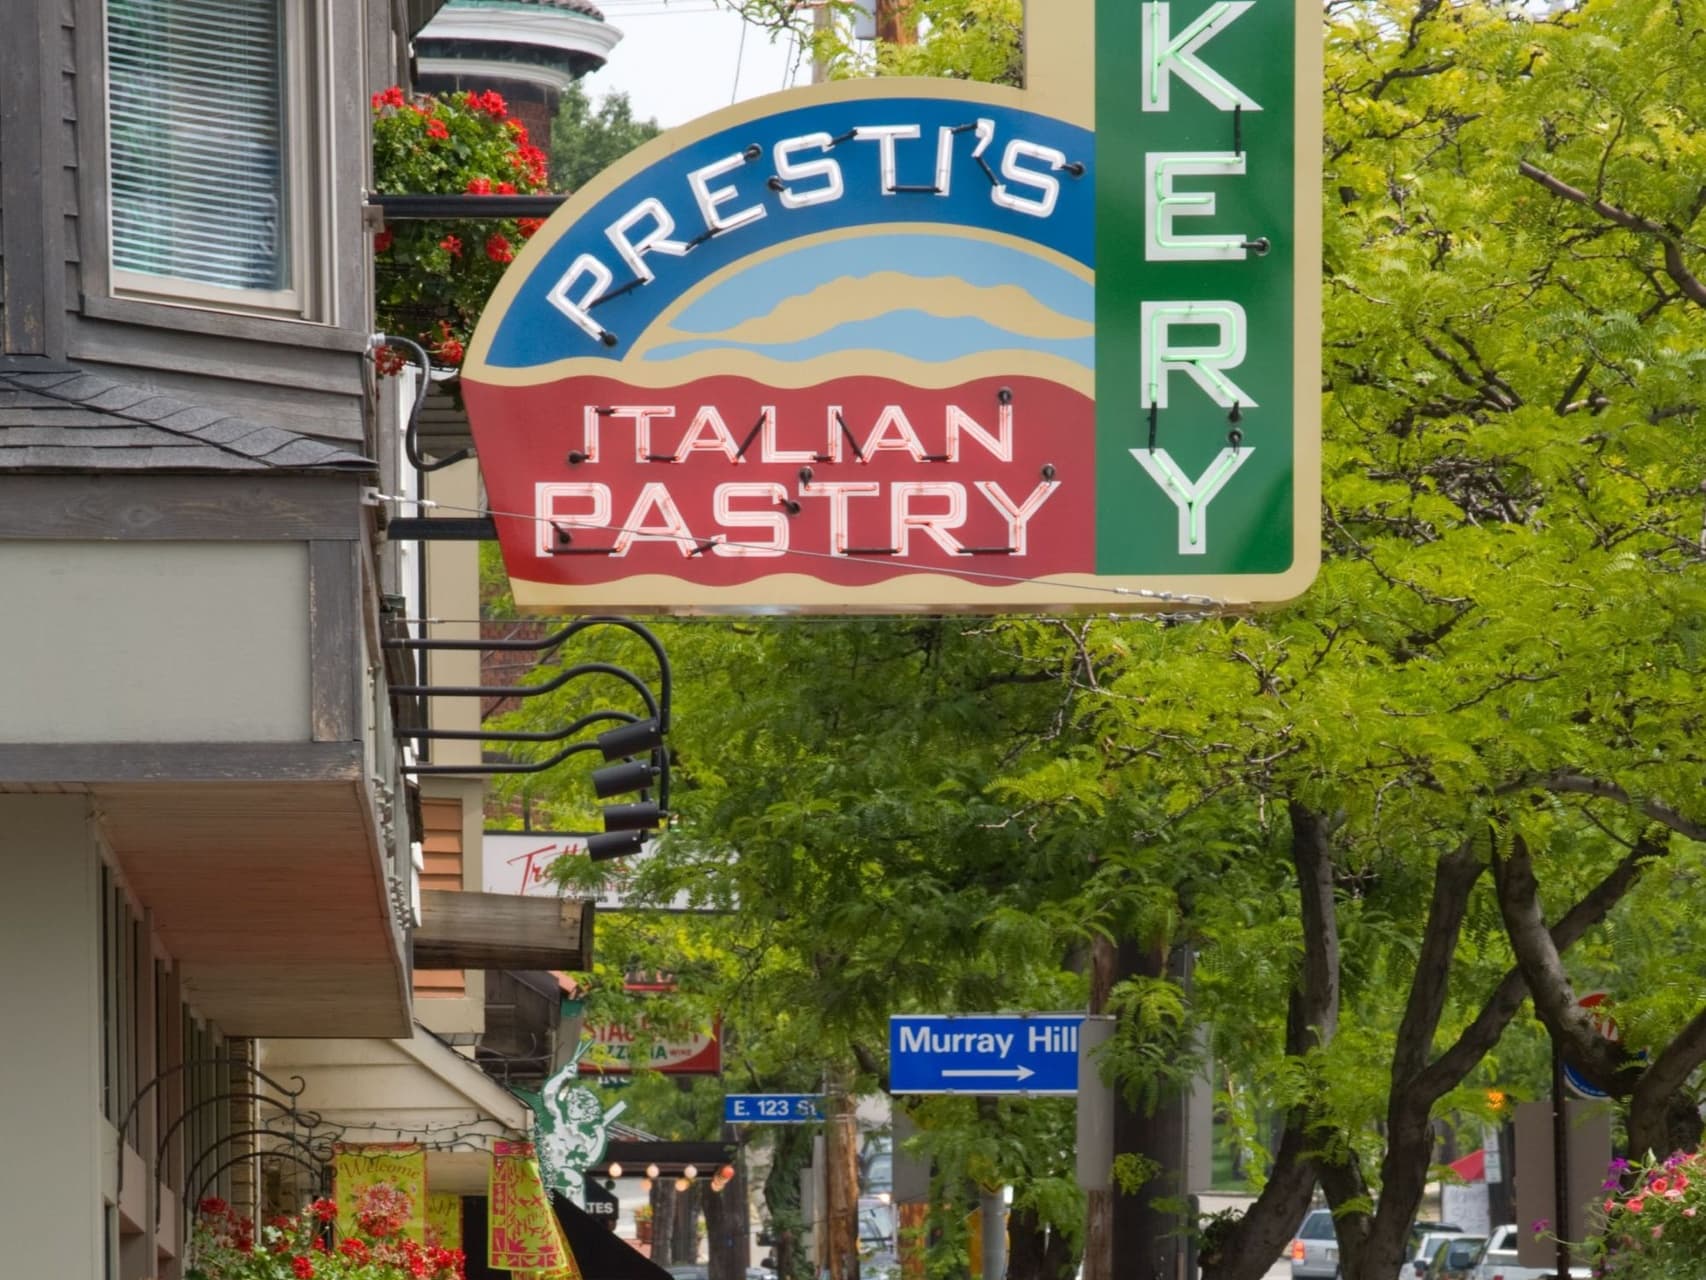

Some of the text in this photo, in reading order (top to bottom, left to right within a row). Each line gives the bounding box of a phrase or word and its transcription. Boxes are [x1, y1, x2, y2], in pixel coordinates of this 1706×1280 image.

[546, 118, 1069, 341] PRESTI'S
[583, 404, 1014, 464] ITALIAN
[535, 481, 1062, 558] PASTRY
[900, 1026, 1077, 1059] Murray Hill
[734, 1100, 817, 1116] E. 123 St
[340, 1159, 421, 1179] Welcome
[584, 1202, 614, 1215] TES
